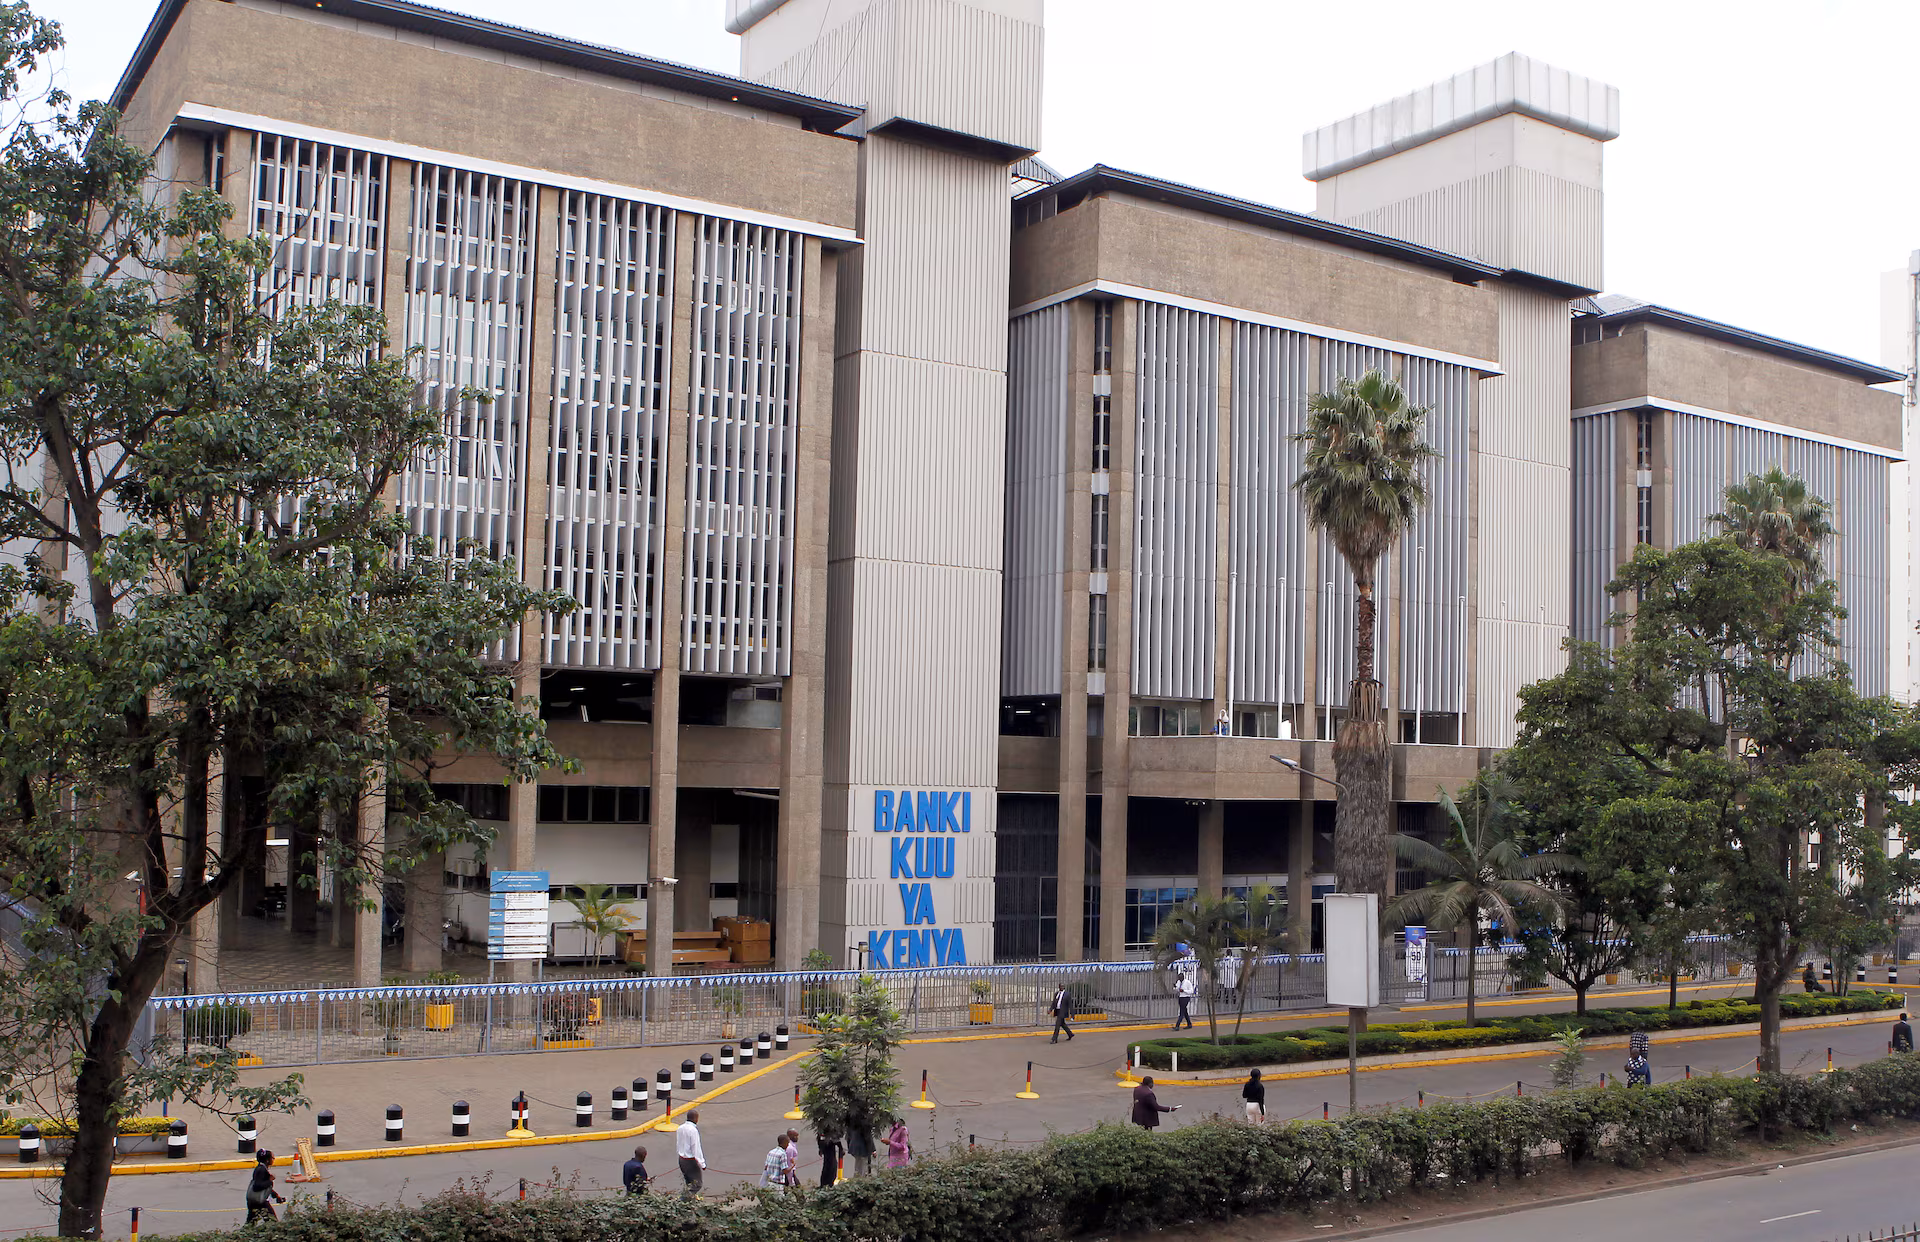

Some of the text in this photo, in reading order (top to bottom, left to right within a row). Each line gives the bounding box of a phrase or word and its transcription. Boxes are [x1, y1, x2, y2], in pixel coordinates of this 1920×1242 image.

[874, 789, 971, 832] BANKI
[891, 837, 955, 879] KUU
[899, 883, 936, 925] YA
[868, 928, 967, 968] KENYA
